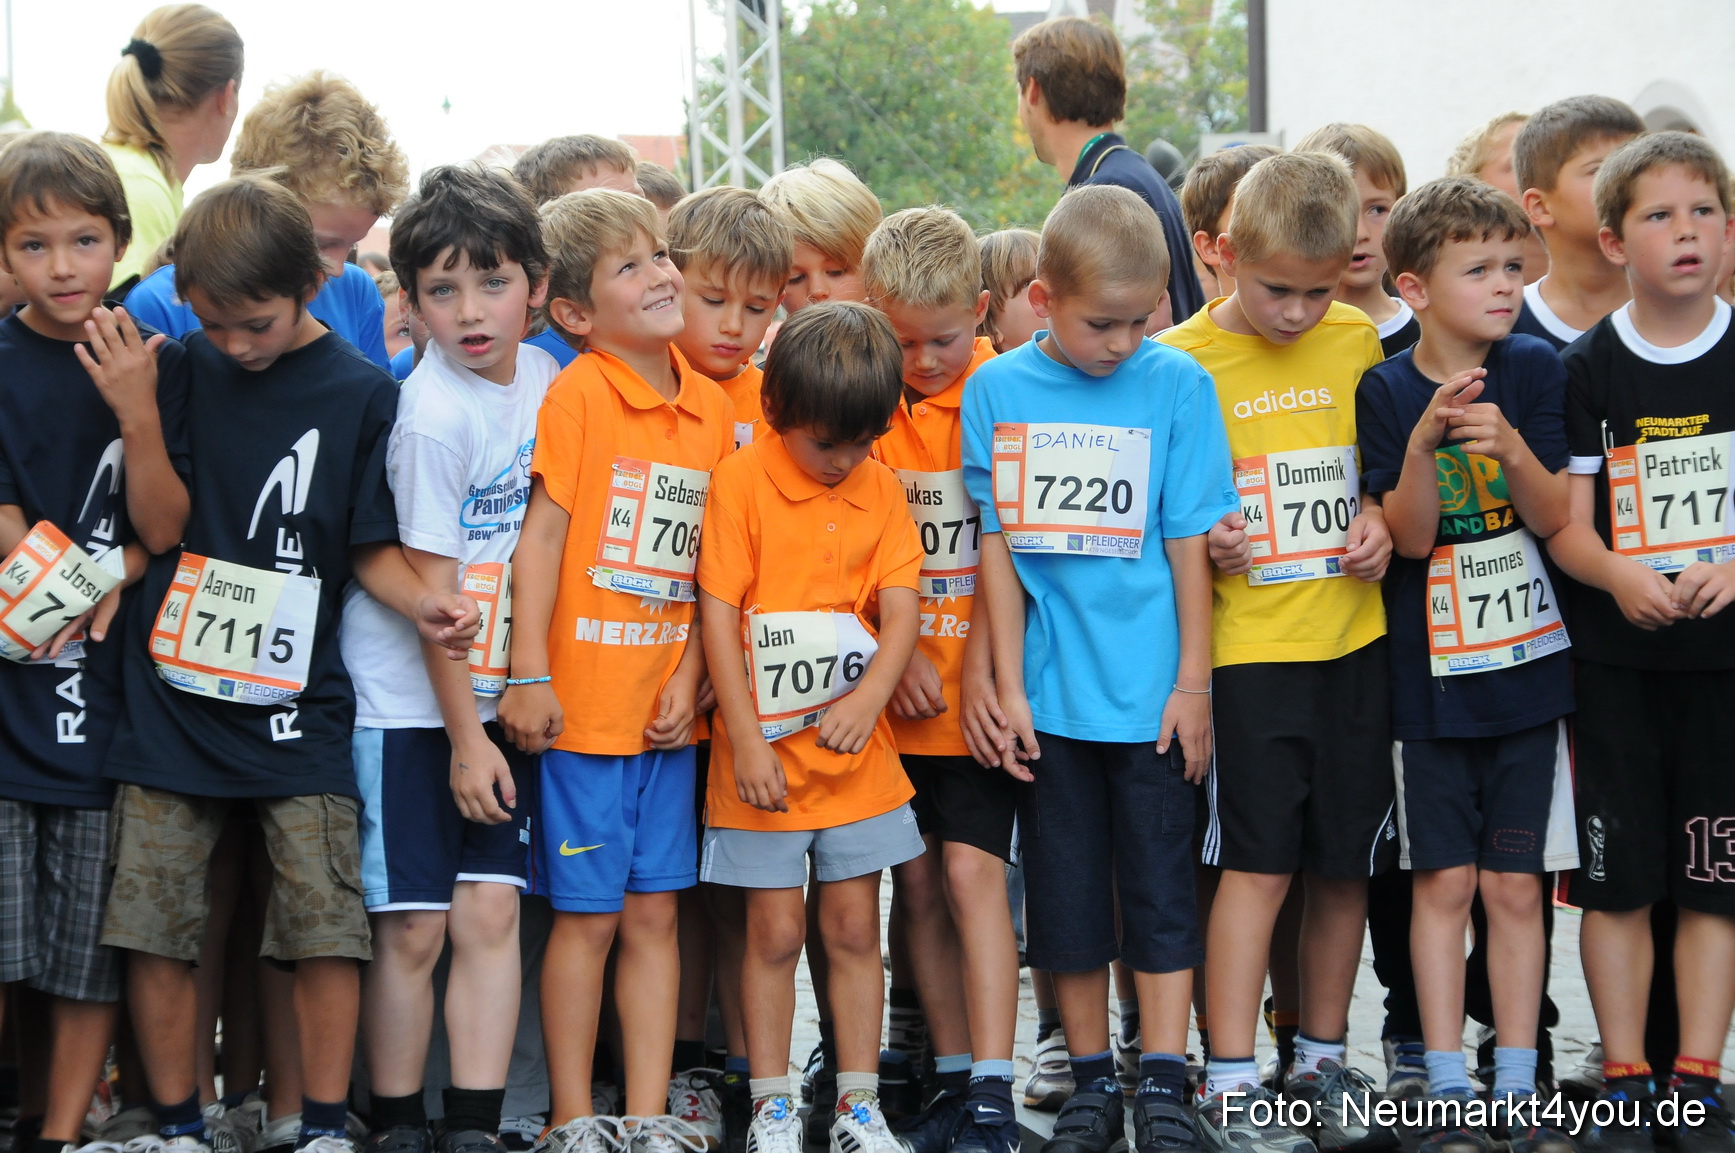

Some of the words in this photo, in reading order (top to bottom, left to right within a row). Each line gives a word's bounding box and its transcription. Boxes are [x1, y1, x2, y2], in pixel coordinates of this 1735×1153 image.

[1233, 386, 1333, 420] adidas
[1635, 414, 1710, 428] NEUMARKTER
[1641, 425, 1704, 438] STADTLAUF
[1276, 456, 1347, 487] Dominik
[1645, 446, 1723, 479] Patrick
[907, 480, 943, 506] ukas
[1034, 475, 1133, 515] 7220
[611, 507, 631, 528] K4
[1243, 504, 1263, 524] K4
[1617, 497, 1634, 517] K4
[1652, 486, 1735, 530] 717
[917, 514, 981, 556] 077
[1441, 507, 1514, 536] ANDBA
[652, 516, 698, 559] 706
[1085, 536, 1140, 550] PFLEIDERER
[4, 560, 30, 586] K4
[1261, 564, 1303, 578] BOCK
[1460, 550, 1524, 579] Hannes
[201, 569, 256, 605] Aaron
[611, 574, 653, 589] BOCK
[163, 600, 181, 621] K4
[1432, 596, 1449, 615] K4
[1468, 577, 1550, 629] 7172
[194, 610, 296, 664] 7115
[575, 617, 659, 645] MERZ
[758, 624, 795, 648] Jan
[764, 651, 864, 698] 7076
[1449, 655, 1491, 668] BOCK
